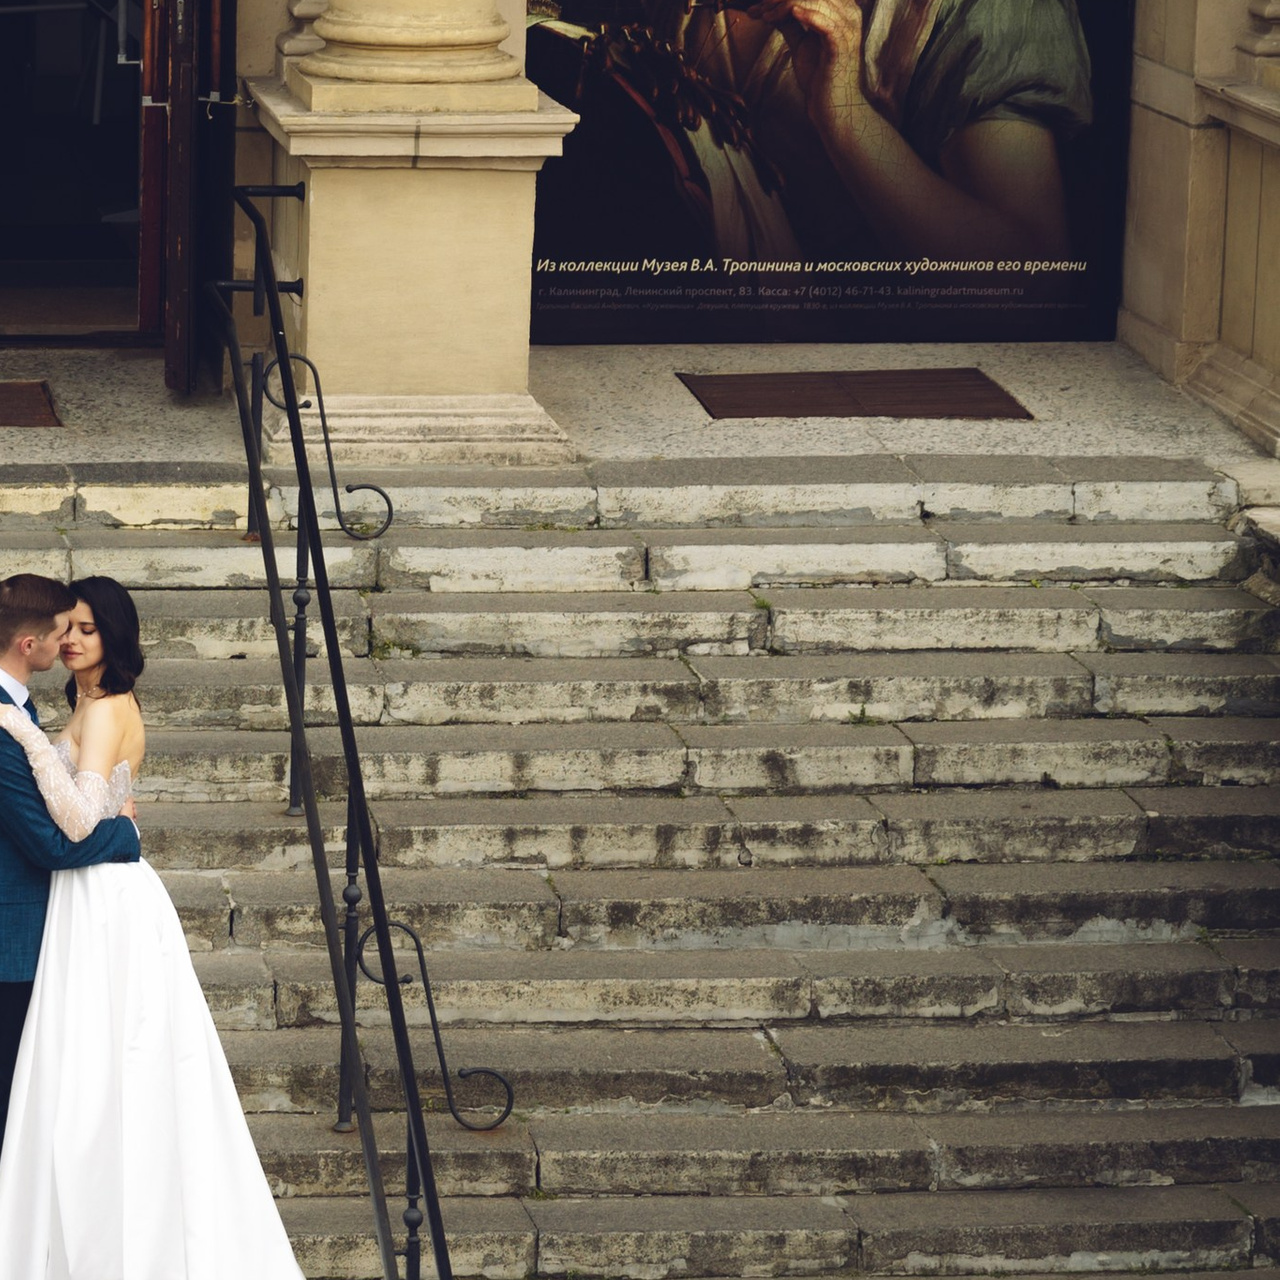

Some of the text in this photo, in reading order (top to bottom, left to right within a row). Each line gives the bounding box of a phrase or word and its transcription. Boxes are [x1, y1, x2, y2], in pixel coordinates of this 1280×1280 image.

[536, 257, 1087, 276] Из коллекции Музея В.А. Тропинина и московских художников его времени
[549, 287, 623, 299] Калининград,
[625, 286, 683, 296] Ленинский
[685, 288, 736, 299] проспект,
[758, 287, 791, 296] Касса:
[794, 287, 806, 296] +7
[809, 286, 842, 298] (4012)
[897, 286, 1024, 298] kaliningradartmuseum.ru
